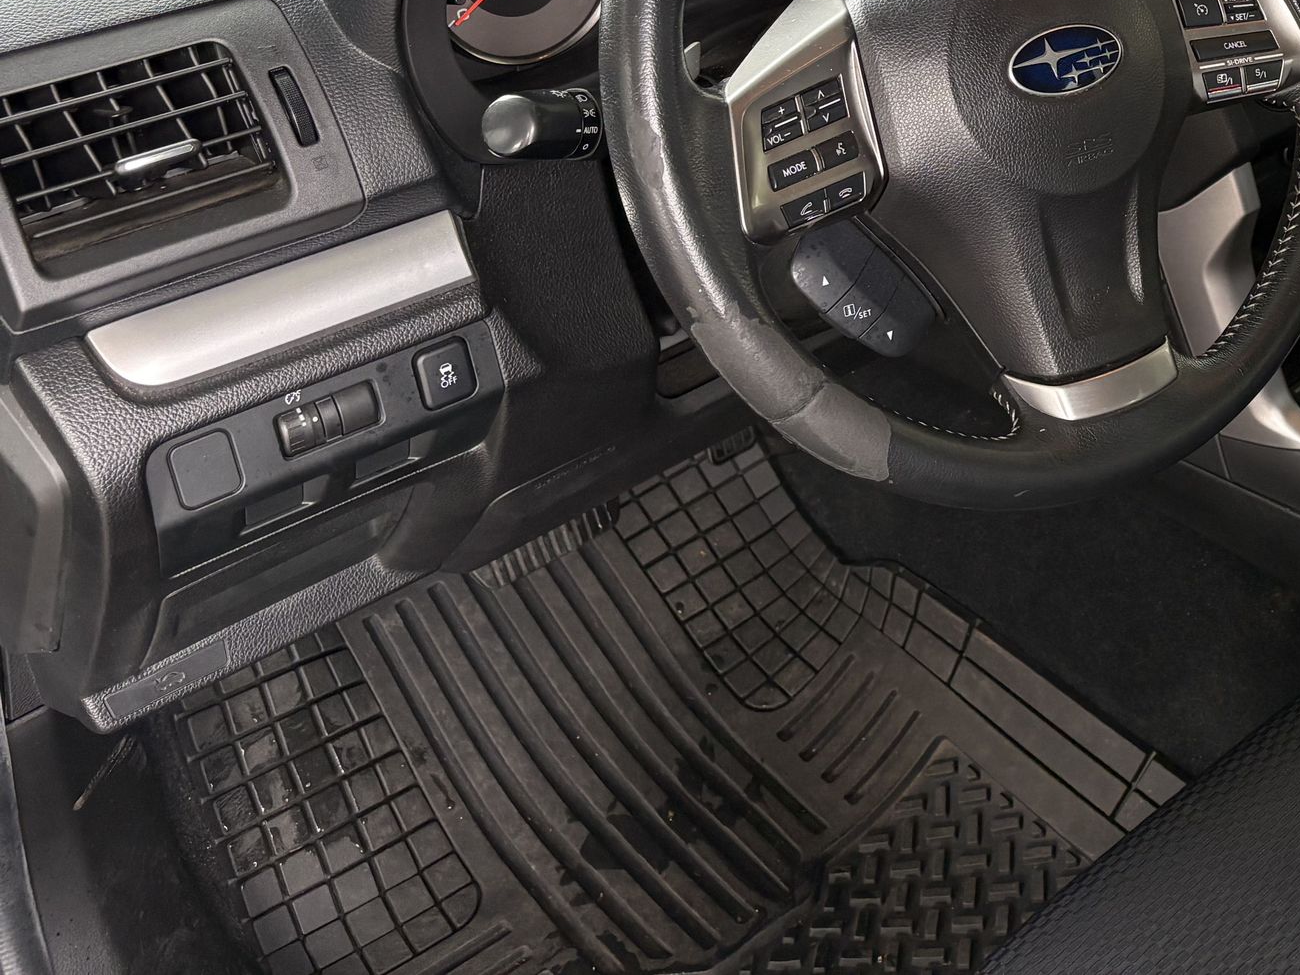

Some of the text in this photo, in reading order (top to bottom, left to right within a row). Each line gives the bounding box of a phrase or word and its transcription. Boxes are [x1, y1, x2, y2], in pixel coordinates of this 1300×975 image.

[1224, 41, 1247, 50] CANCEL
[1227, 57, 1253, 66] SI-DRIVE
[782, 161, 807, 177] MODE
[441, 375, 458, 388] OFF
